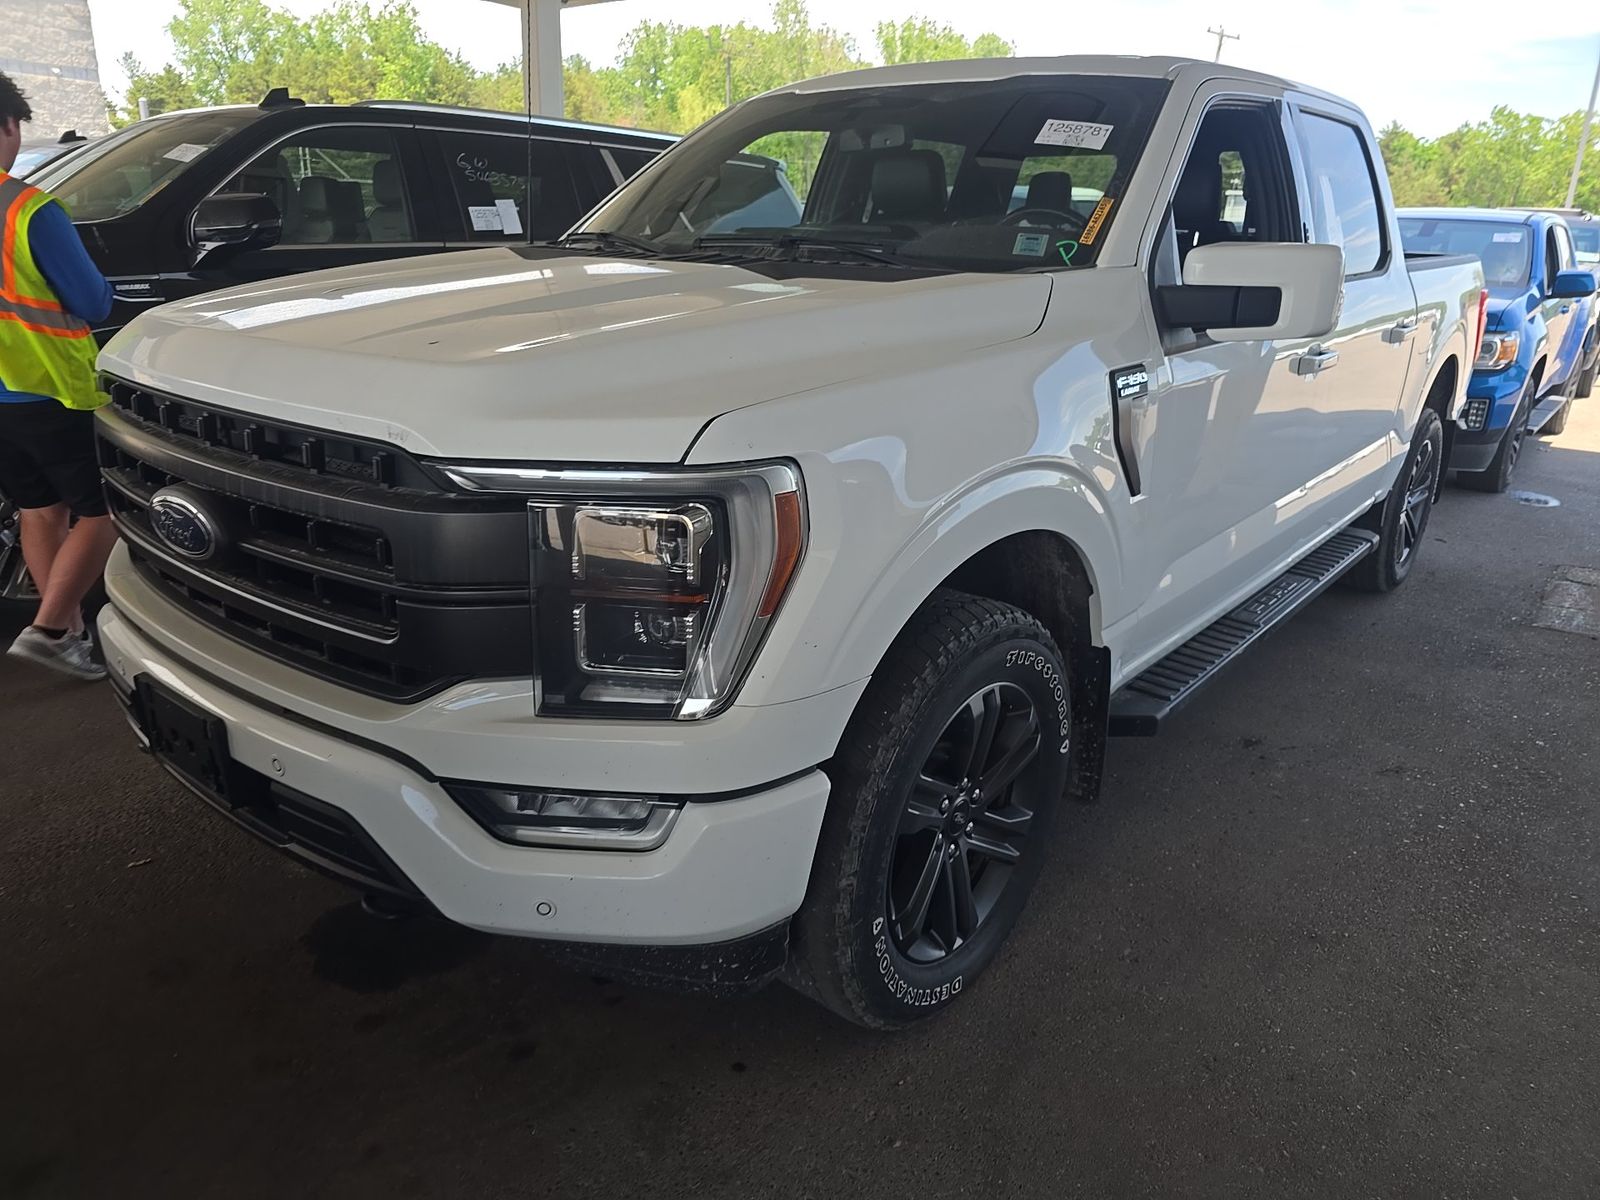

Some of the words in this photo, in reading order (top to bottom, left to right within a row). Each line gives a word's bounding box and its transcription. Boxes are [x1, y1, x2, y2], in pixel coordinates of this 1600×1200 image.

[1047, 122, 1110, 138] 1258781
[1056, 240, 1078, 268] P
[1005, 649, 1069, 737] Firestone
[874, 935, 964, 1007] DESTINATION
